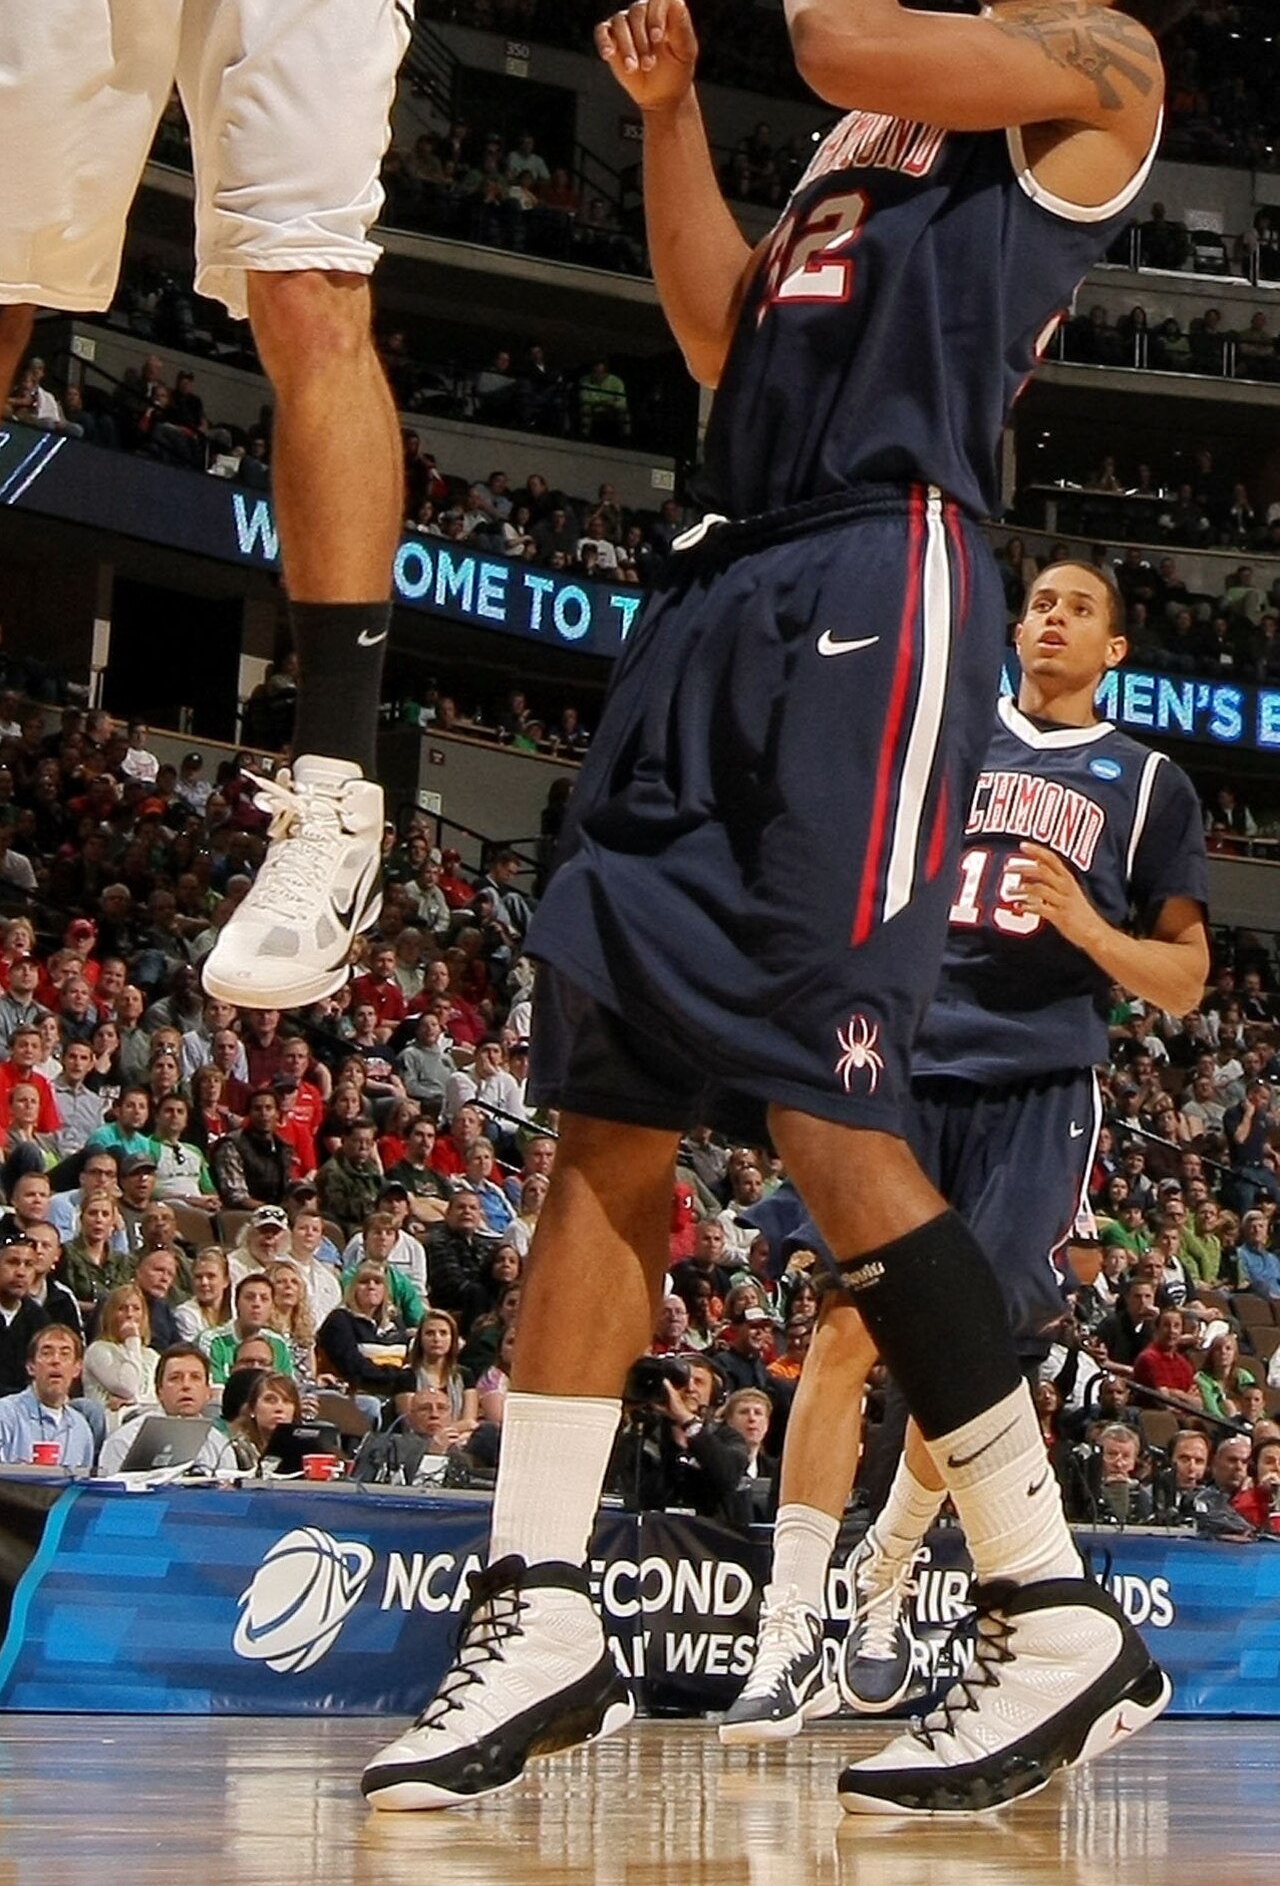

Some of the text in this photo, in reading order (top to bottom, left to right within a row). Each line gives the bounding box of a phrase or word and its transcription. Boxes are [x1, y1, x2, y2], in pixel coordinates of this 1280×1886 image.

[505, 41, 531, 59] 350
[524, 575, 592, 642] TO
[949, 849, 1044, 937] 15
